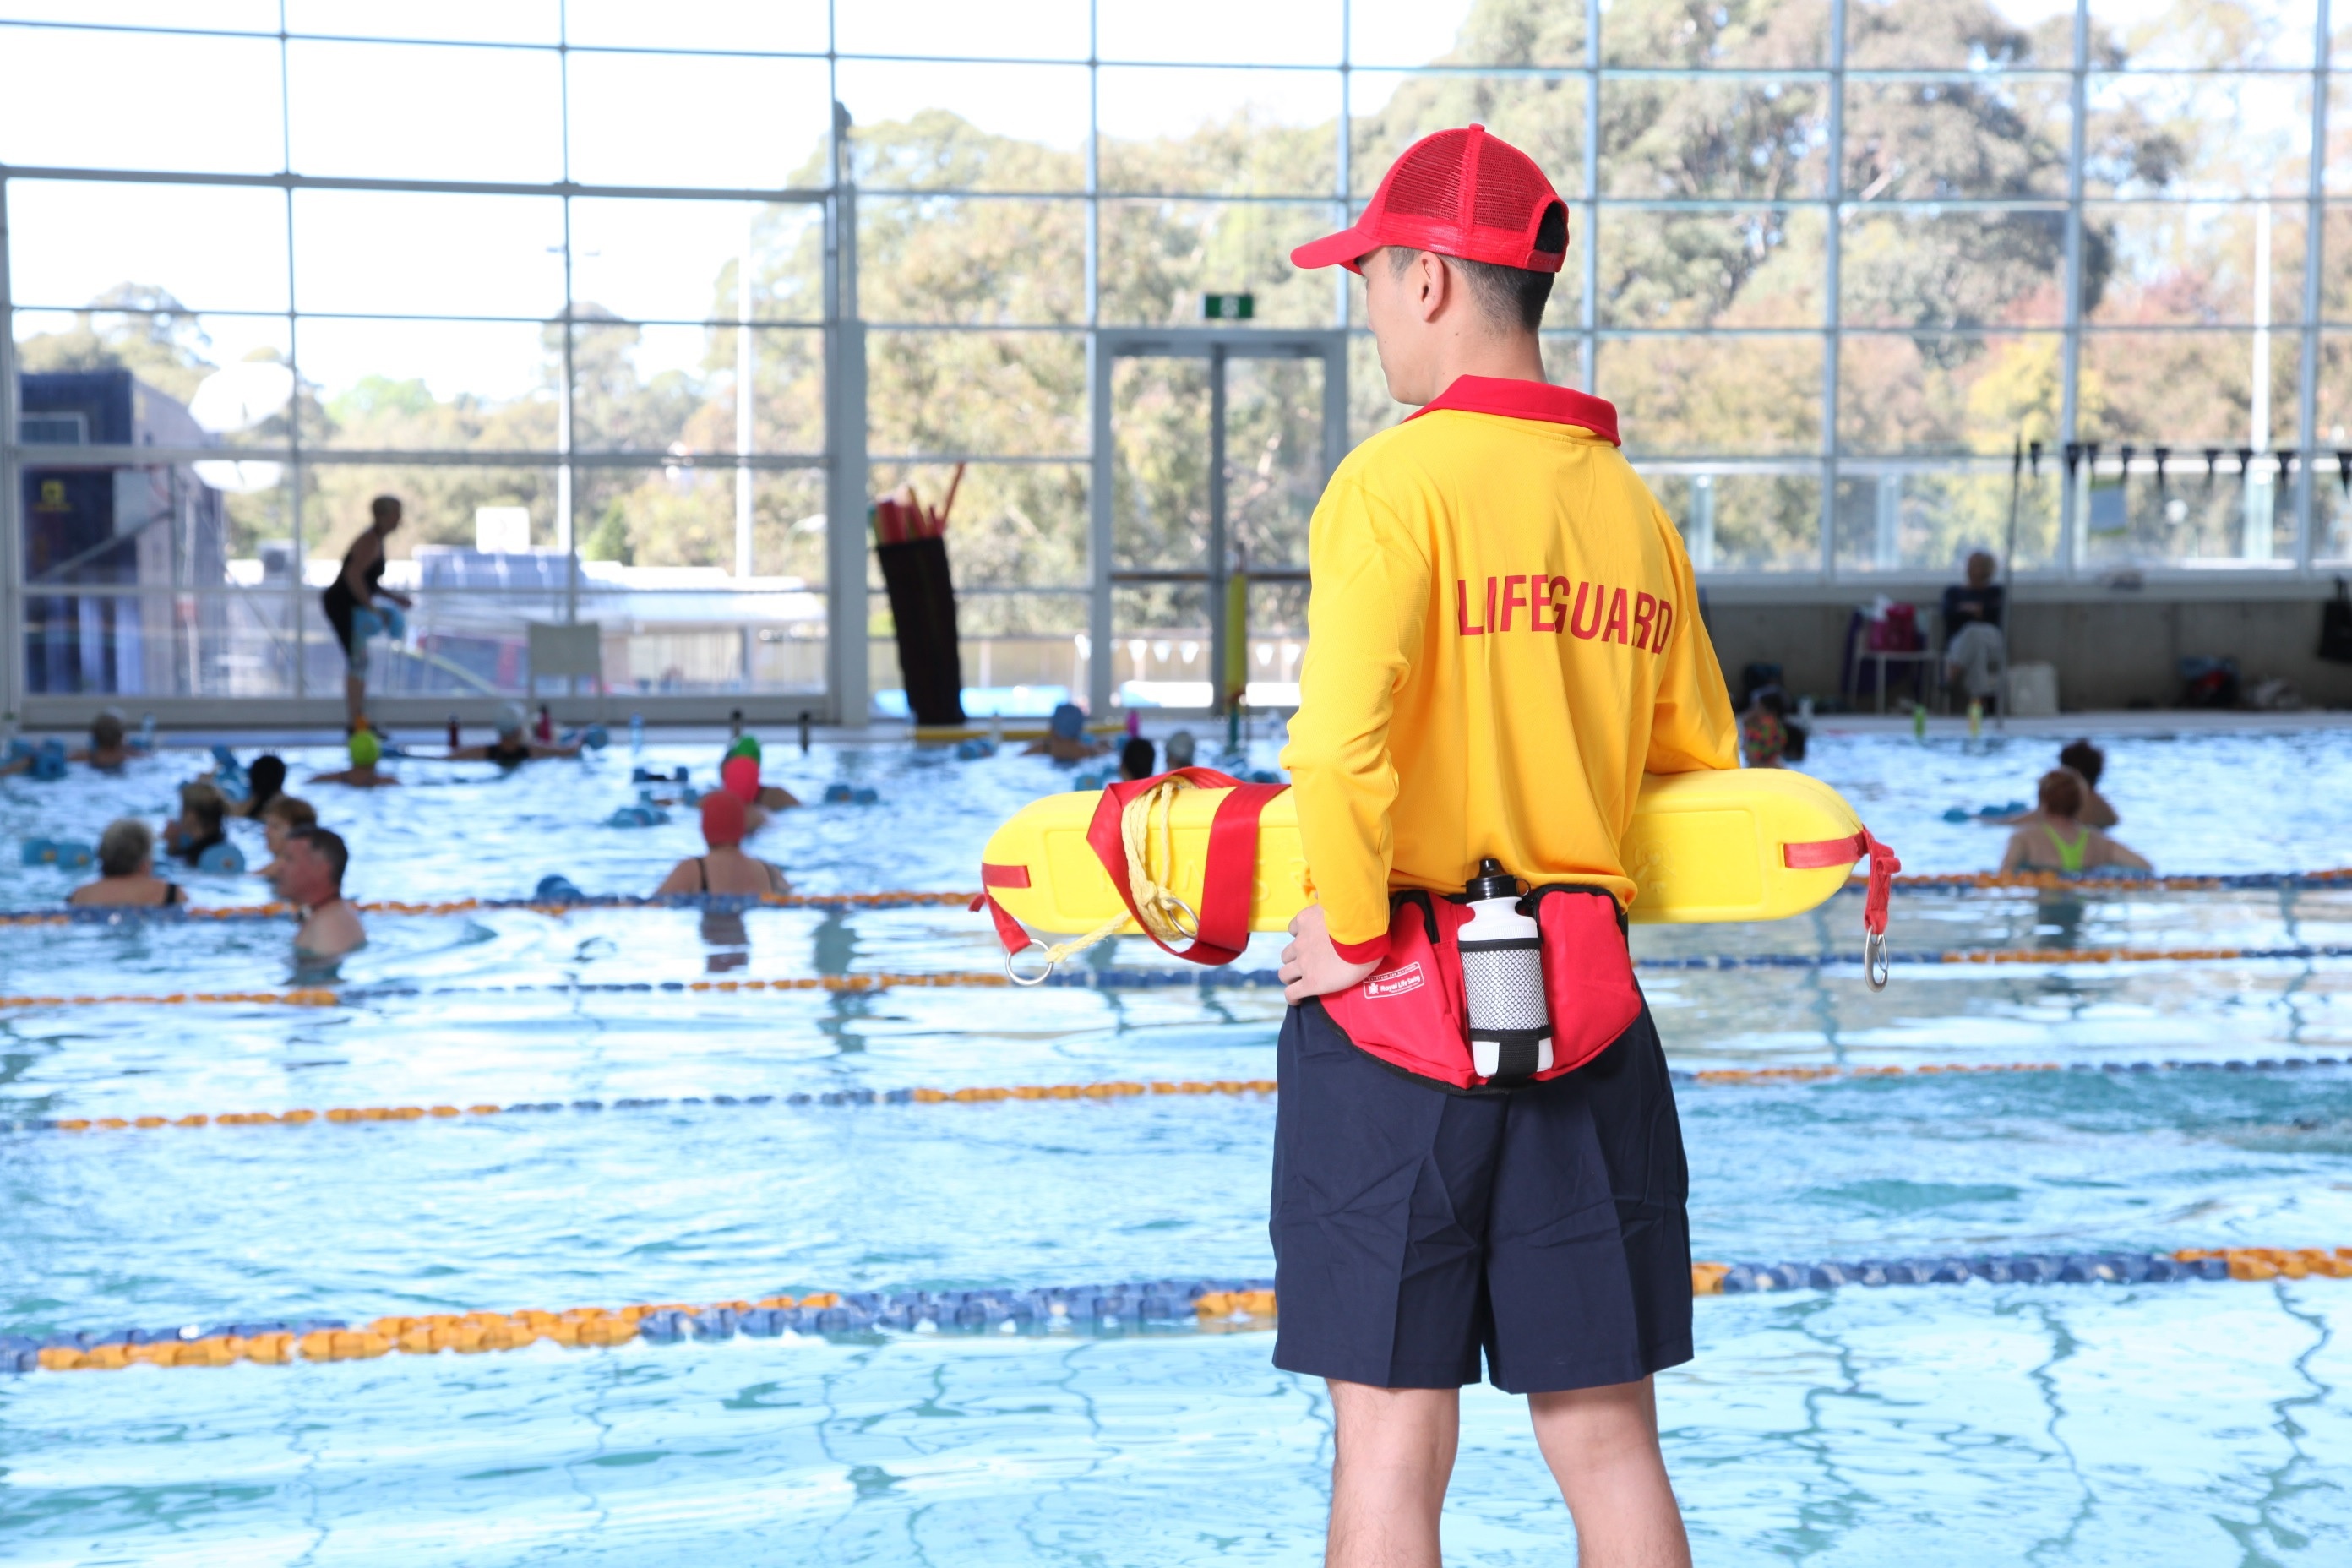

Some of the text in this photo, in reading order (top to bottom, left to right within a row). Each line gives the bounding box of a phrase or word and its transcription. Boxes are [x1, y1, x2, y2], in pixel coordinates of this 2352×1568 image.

[1457, 574, 1673, 655] LIFEGUARD
[1380, 982, 1398, 992] Royal
[1398, 980, 1407, 988] Life
[1407, 976, 1421, 985] Saving
